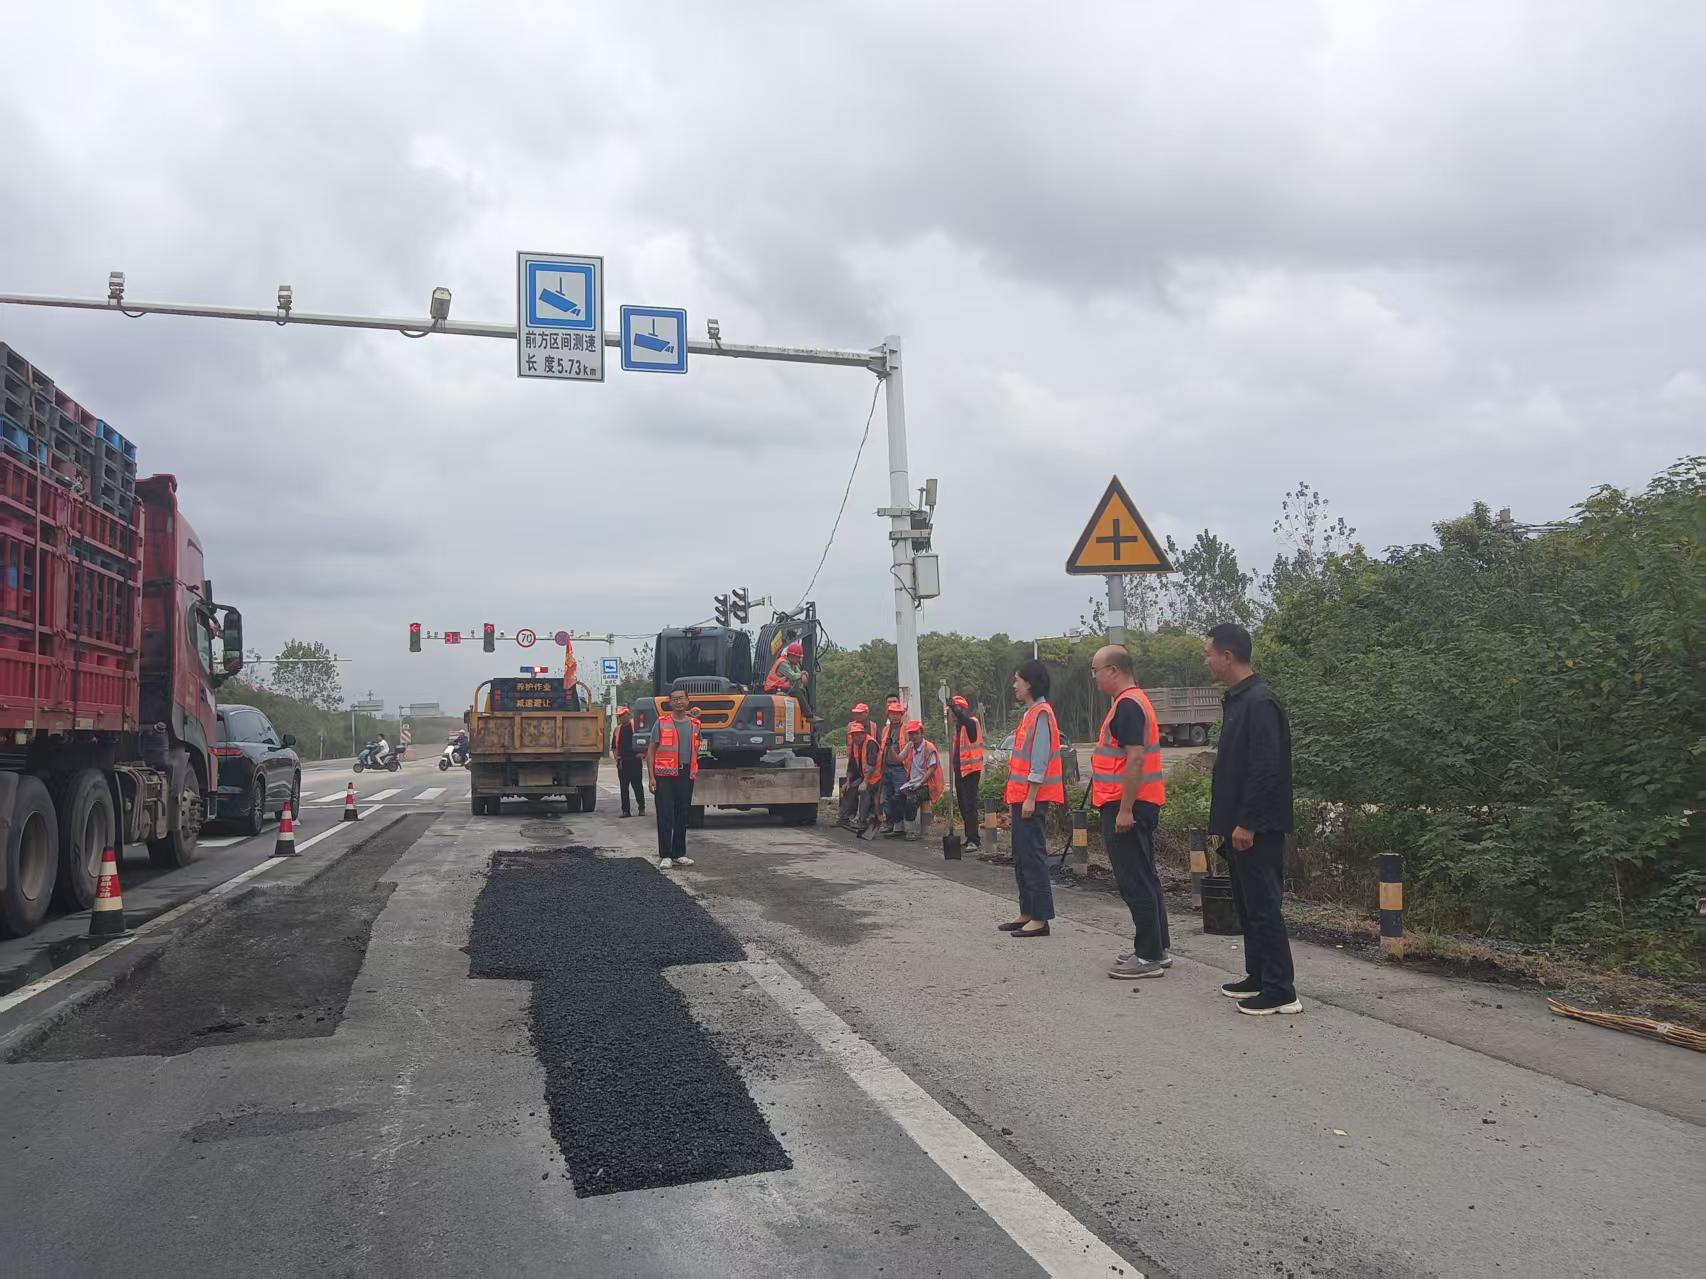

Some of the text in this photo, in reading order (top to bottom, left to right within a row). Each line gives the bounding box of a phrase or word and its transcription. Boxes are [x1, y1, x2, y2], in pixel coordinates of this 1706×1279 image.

[525, 330, 596, 352] 前方区间测速
[521, 633, 533, 643] 70
[516, 682, 552, 691] 养护作业
